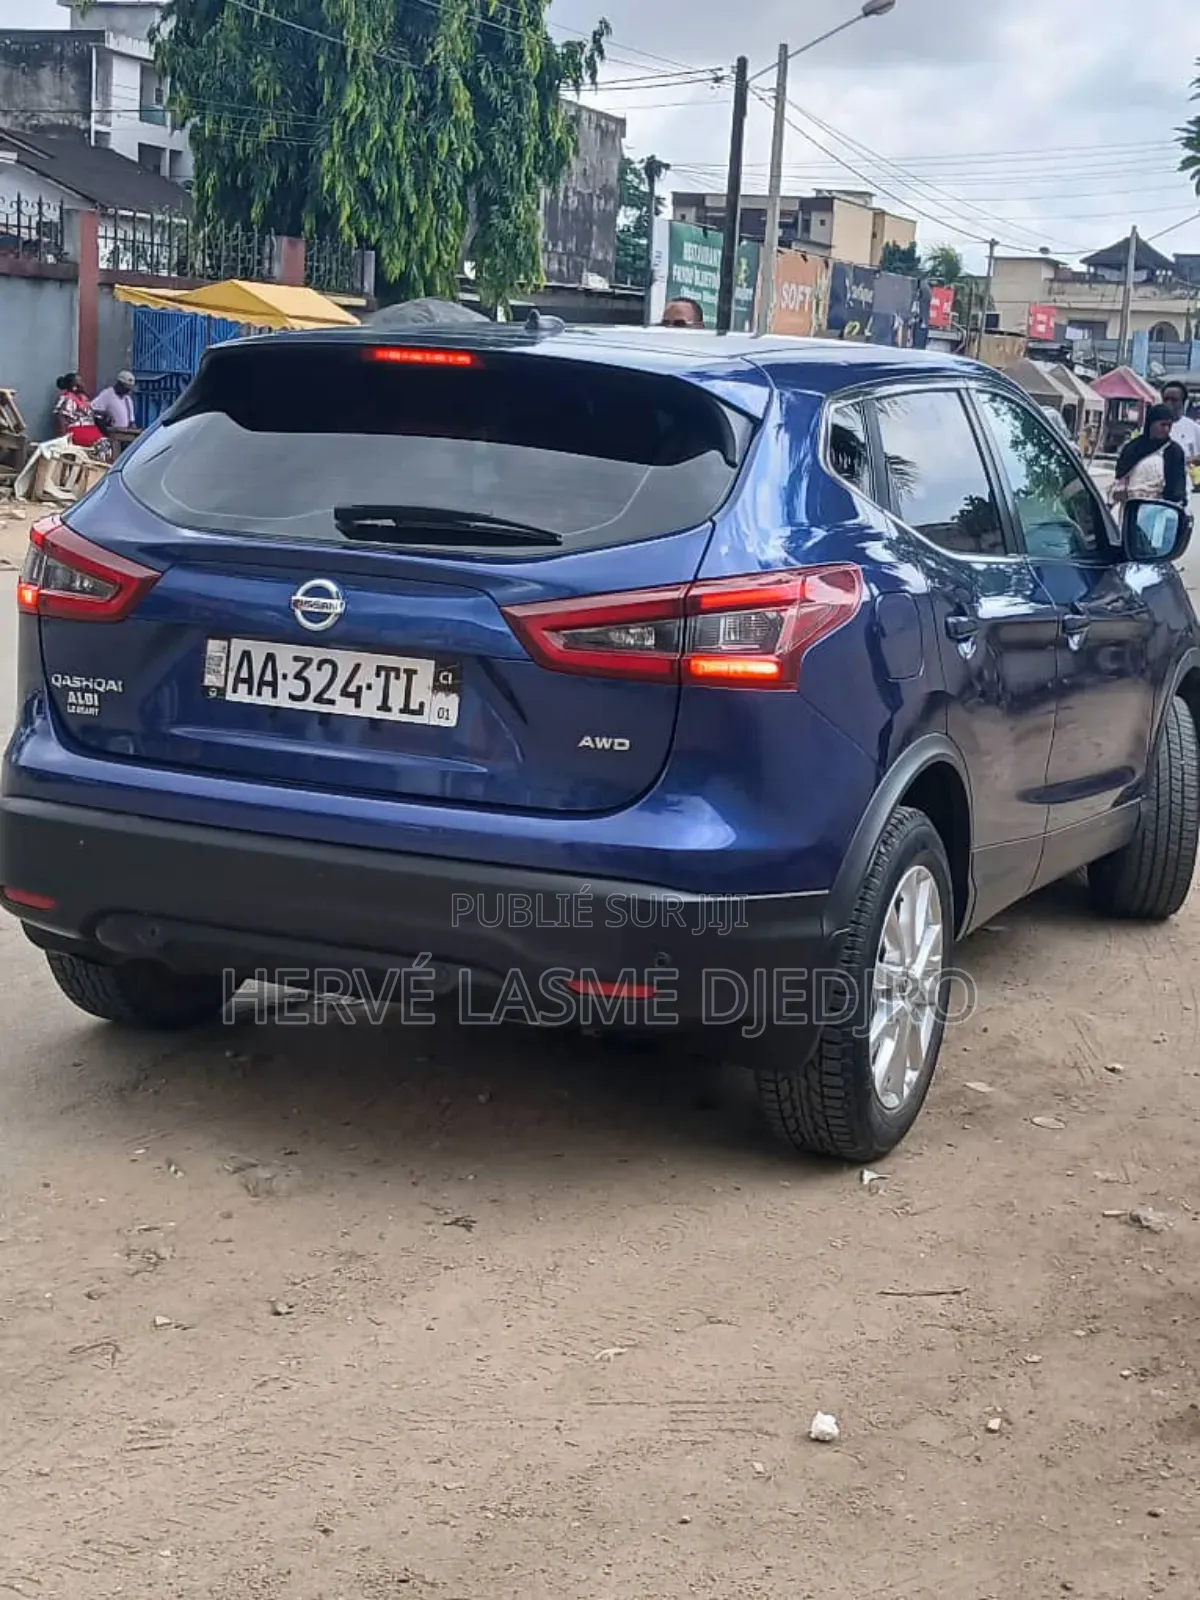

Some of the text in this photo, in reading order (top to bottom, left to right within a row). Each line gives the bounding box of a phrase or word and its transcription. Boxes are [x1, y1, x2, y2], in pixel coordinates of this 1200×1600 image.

[780, 282, 812, 312] SOFT
[51, 673, 124, 692] QASHQAI
[437, 706, 450, 721] 01
[577, 736, 630, 751] AWD
